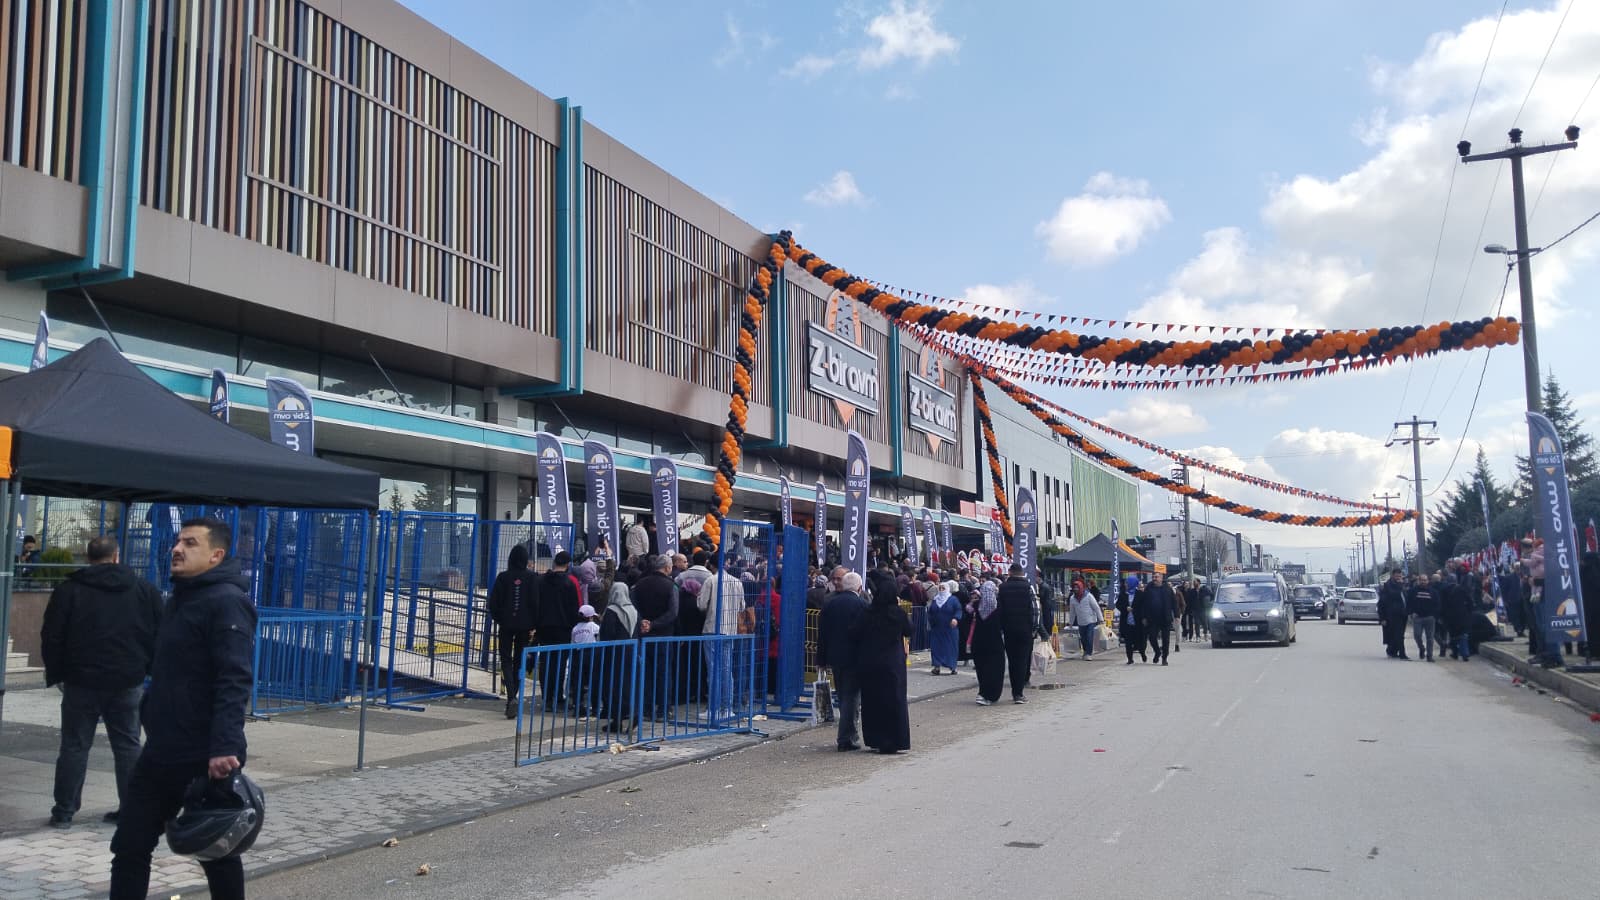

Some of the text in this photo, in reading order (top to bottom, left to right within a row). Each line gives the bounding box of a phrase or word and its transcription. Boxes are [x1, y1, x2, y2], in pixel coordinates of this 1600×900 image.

[810, 338, 879, 401] Z-bir avm
[910, 385, 957, 433] Z-bir avm
